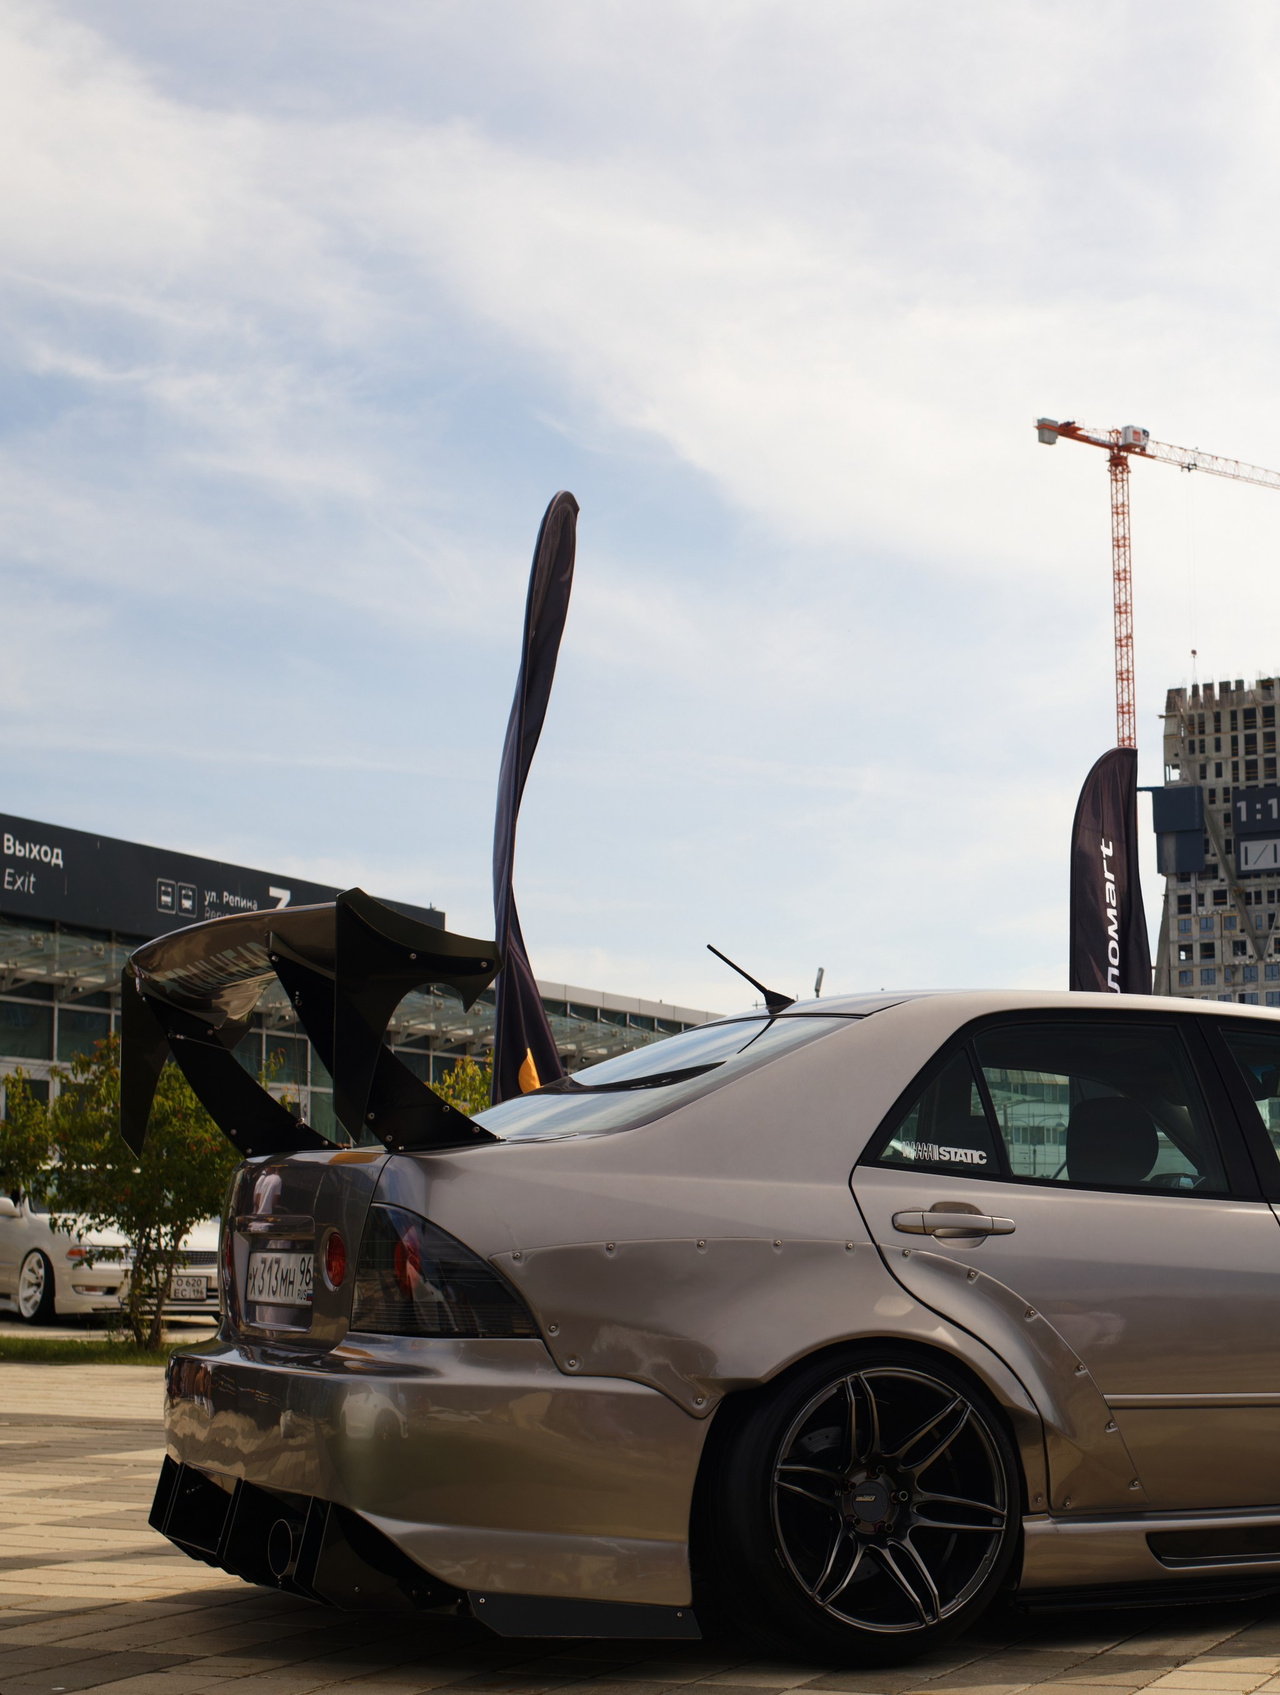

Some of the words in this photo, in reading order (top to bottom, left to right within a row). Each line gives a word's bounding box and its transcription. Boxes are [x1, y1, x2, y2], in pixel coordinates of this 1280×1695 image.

[3, 832, 64, 870] Выход
[3, 868, 37, 895] Exit
[204, 890, 220, 905] ул.
[223, 891, 258, 911] Репина
[939, 1146, 988, 1165] STATIC
[299, 1256, 312, 1287] 96
